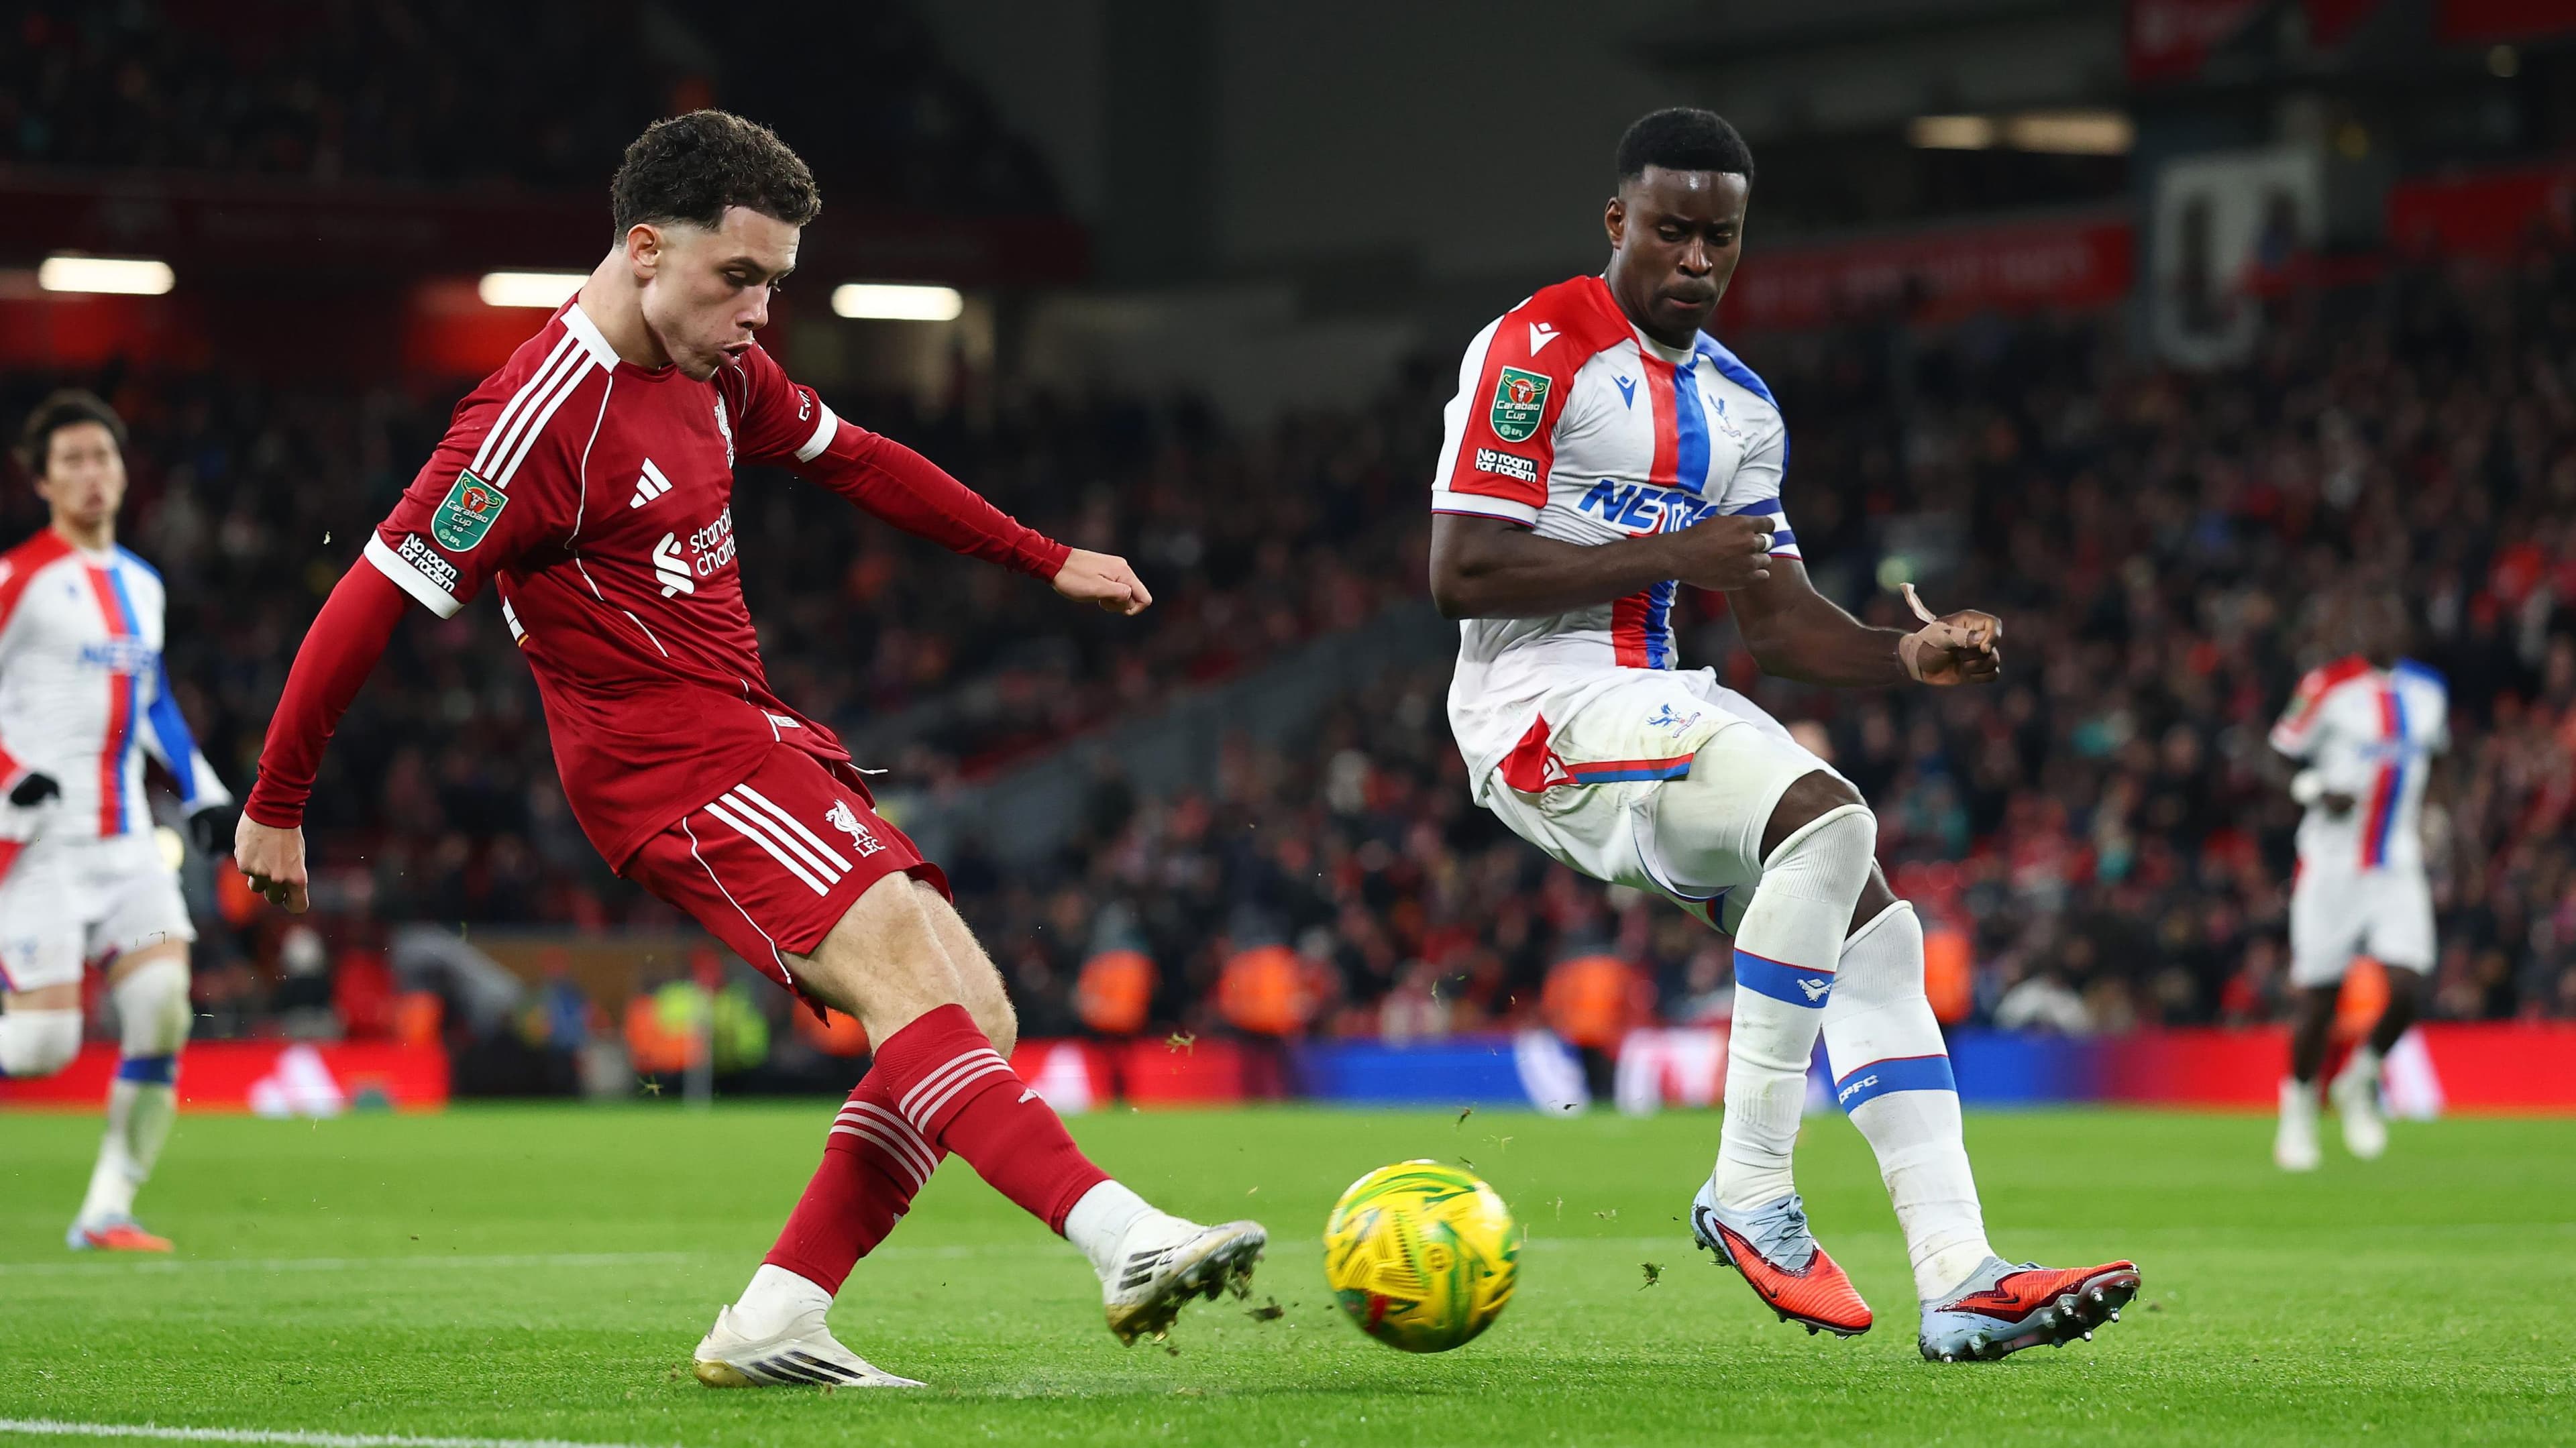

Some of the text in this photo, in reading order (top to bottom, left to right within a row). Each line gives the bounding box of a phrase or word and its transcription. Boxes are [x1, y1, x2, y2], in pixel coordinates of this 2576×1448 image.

[1497, 400, 1540, 411] Carabao
[1505, 410, 1526, 421] Cup
[1511, 428, 1523, 437] EFL
[1477, 448, 1533, 471] No room
[1476, 458, 1536, 483] for racism
[446, 500, 489, 523] Carabao
[451, 513, 472, 526] Cup
[448, 535, 461, 547] EFL
[404, 533, 457, 579] No room
[397, 543, 455, 592] for racism
[855, 839, 885, 858] LFC
